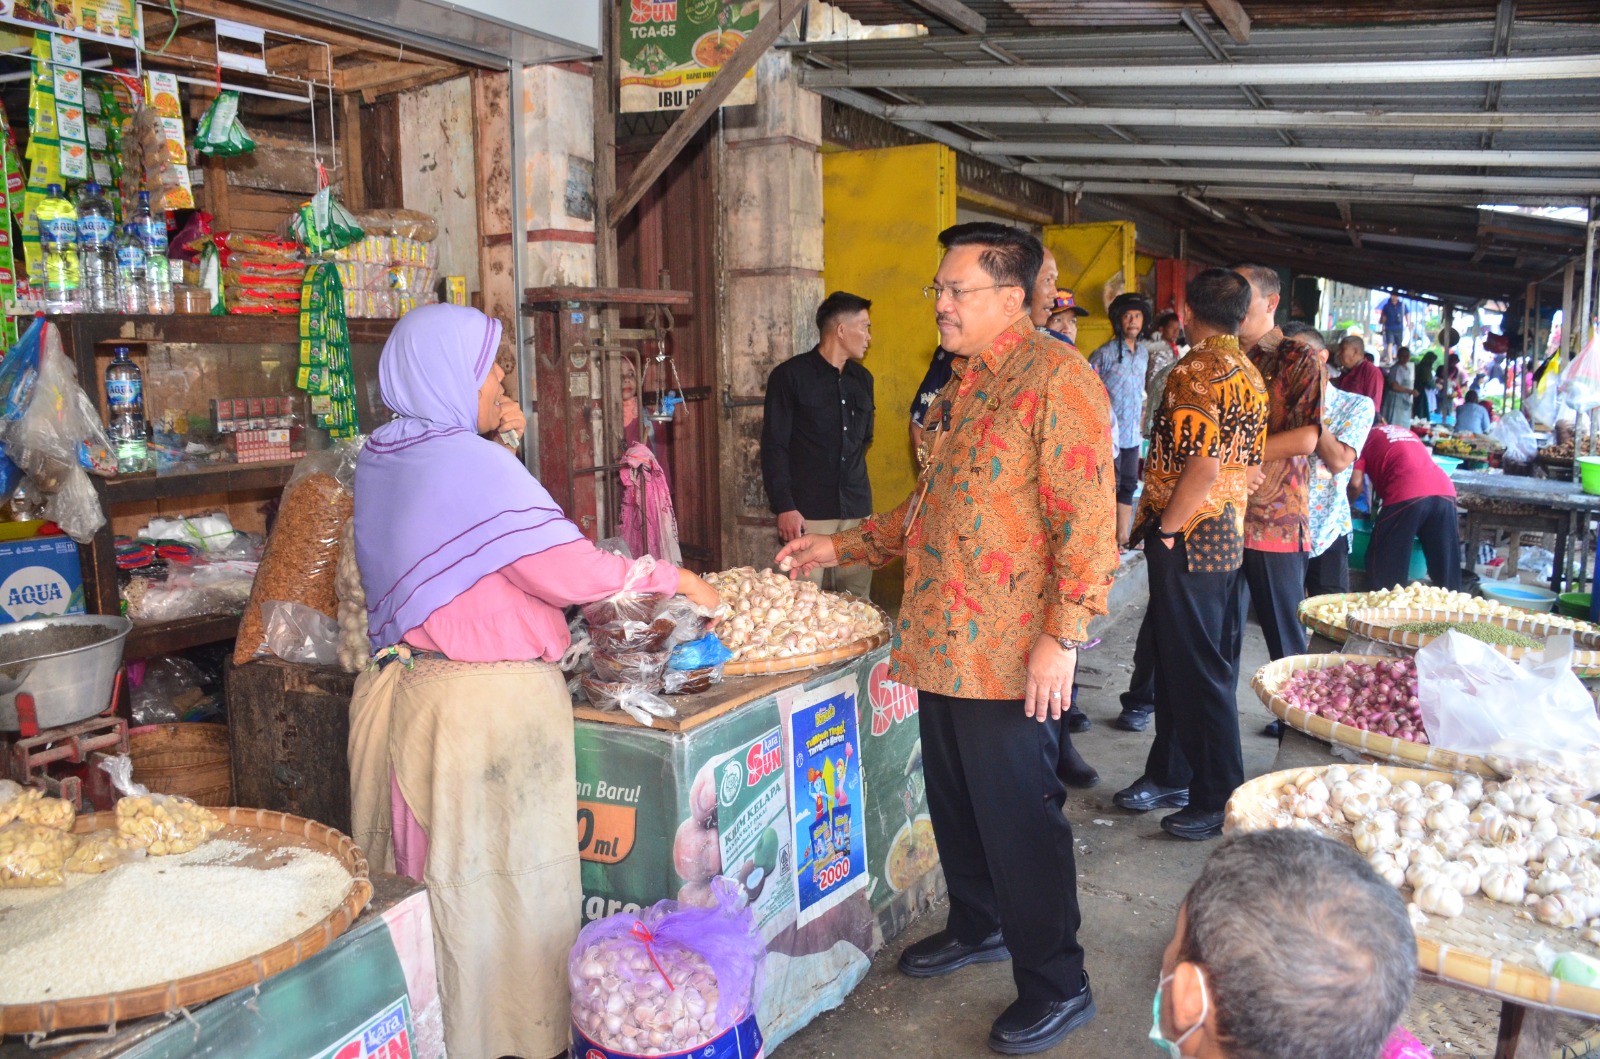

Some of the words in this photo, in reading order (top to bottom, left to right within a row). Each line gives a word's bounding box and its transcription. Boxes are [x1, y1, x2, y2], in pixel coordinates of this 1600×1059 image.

[629, 0, 677, 24] SUN
[630, 24, 676, 39] TCA-65
[686, 72, 702, 80] DAPAT
[658, 90, 683, 107] IBU
[82, 220, 107, 232] AQUA
[109, 385, 133, 395] AQUA
[8, 582, 63, 606] AQUA
[868, 660, 919, 736] SUN
[764, 735, 779, 751] kara
[746, 743, 782, 786] SUN
[596, 780, 641, 803] Baru!
[724, 813, 746, 846] KRIM
[747, 783, 782, 820] KELAPA
[594, 837, 619, 857] ml
[820, 857, 849, 890] 2000
[367, 1014, 401, 1046] kara
